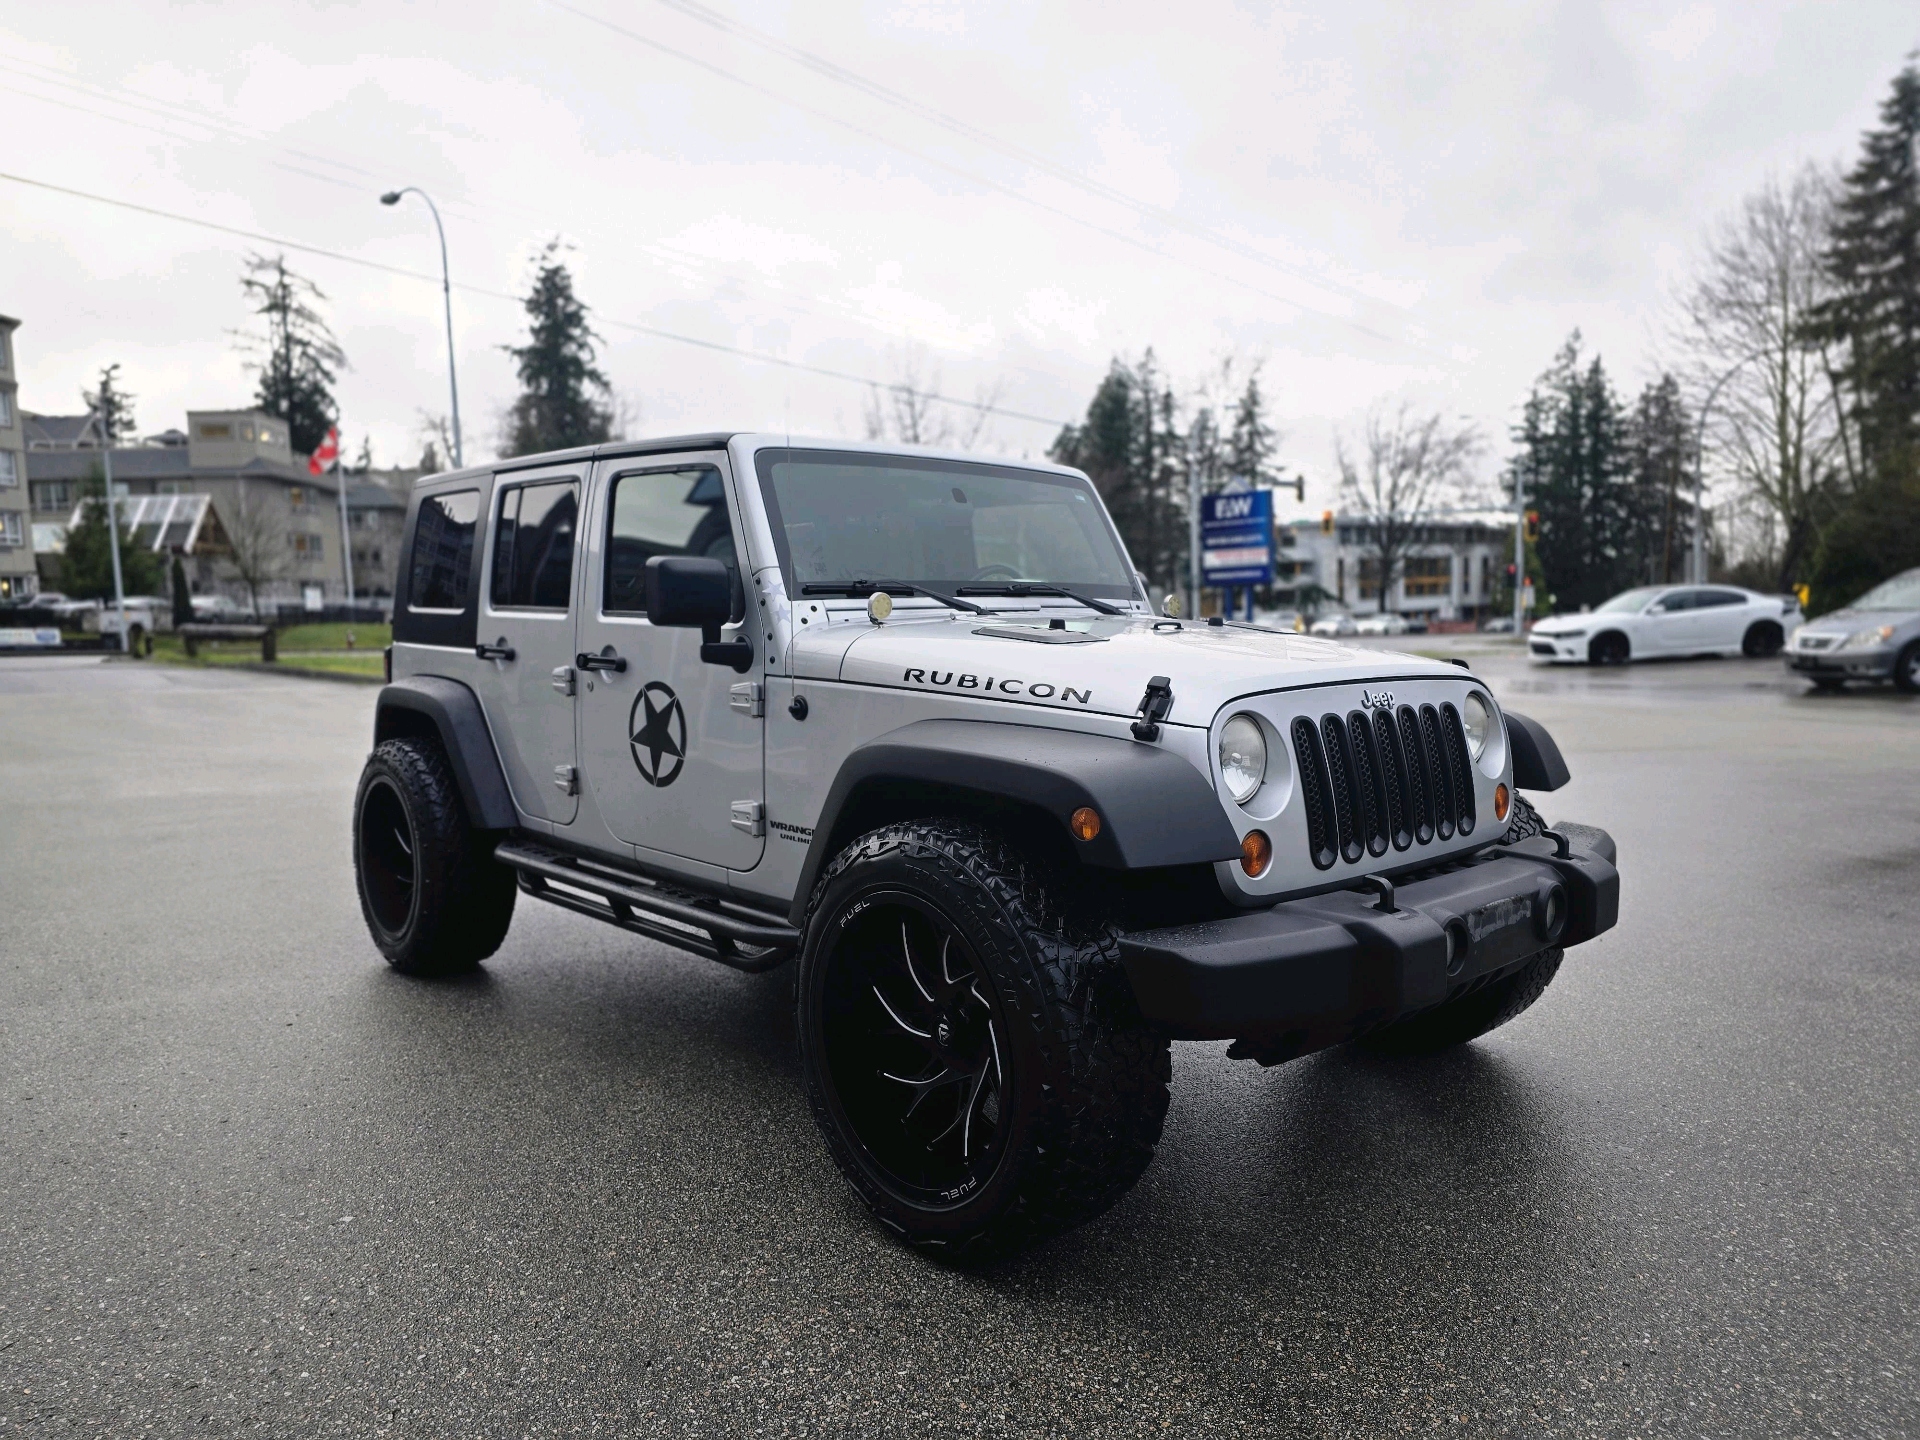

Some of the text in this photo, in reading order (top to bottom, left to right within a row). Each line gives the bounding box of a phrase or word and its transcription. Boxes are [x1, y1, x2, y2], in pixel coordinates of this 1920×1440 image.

[903, 667, 1093, 704] RUBICON
[1361, 689, 1395, 710] Jeep
[780, 833, 812, 845] UNLIMI
[839, 900, 871, 928] FUEL
[940, 1175, 977, 1200] FUEL
